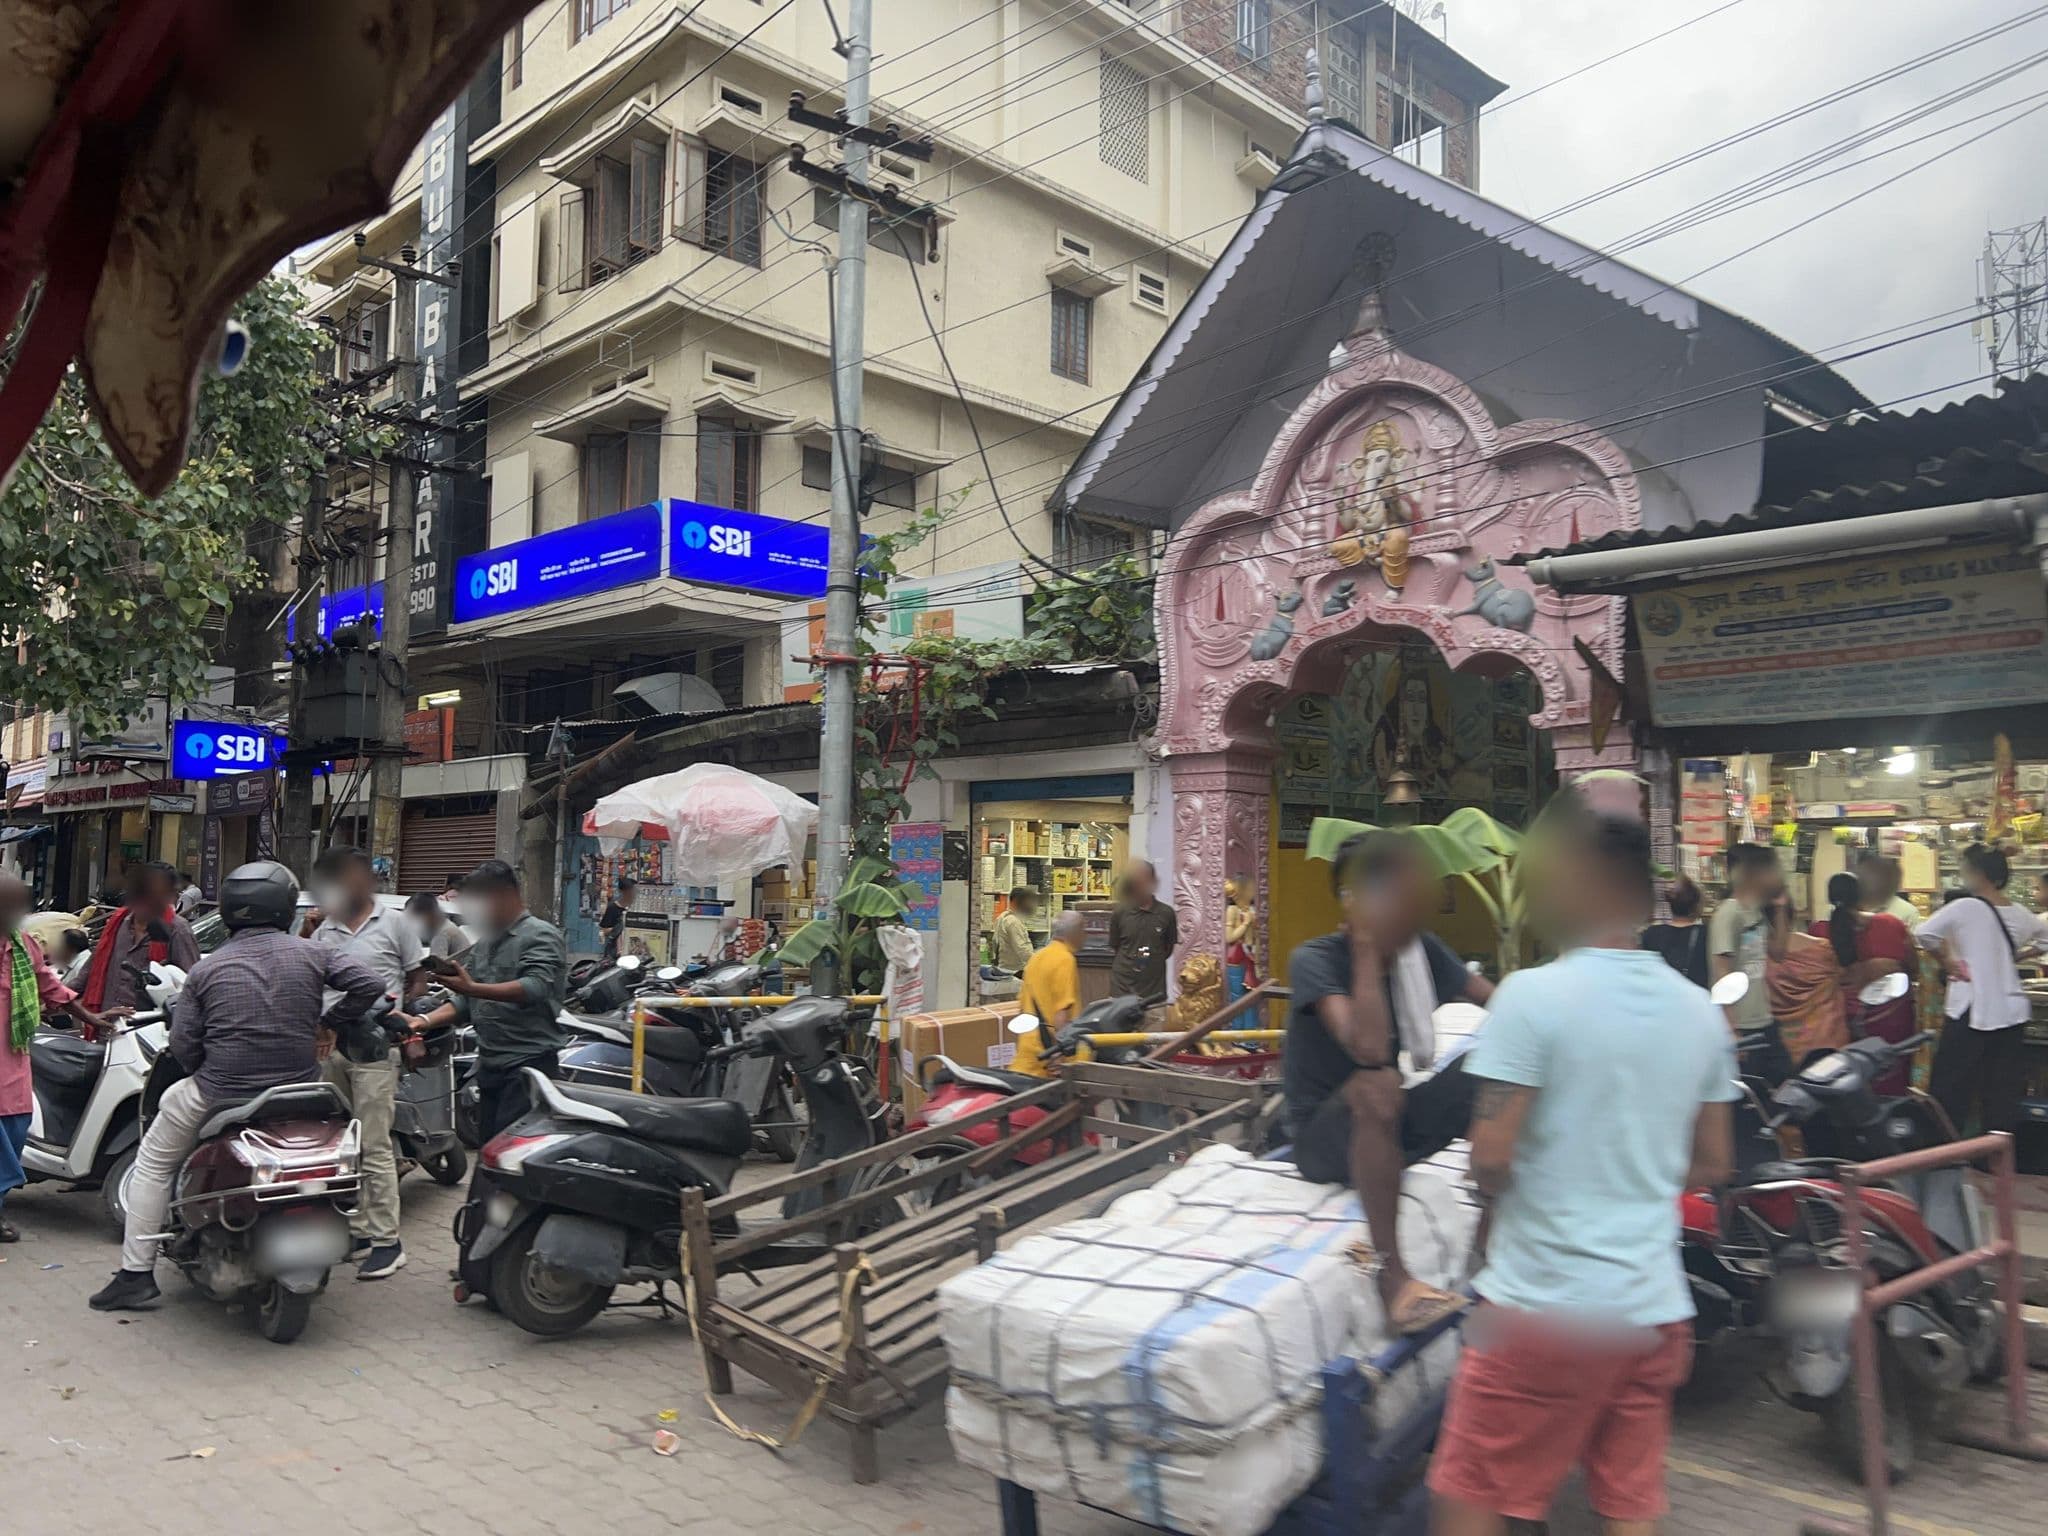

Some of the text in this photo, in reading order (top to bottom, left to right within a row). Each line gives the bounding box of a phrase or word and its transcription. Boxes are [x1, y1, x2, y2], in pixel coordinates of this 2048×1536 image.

[708, 524, 751, 558] SBI
[487, 559, 518, 597] SBI
[215, 733, 265, 763] SBI
